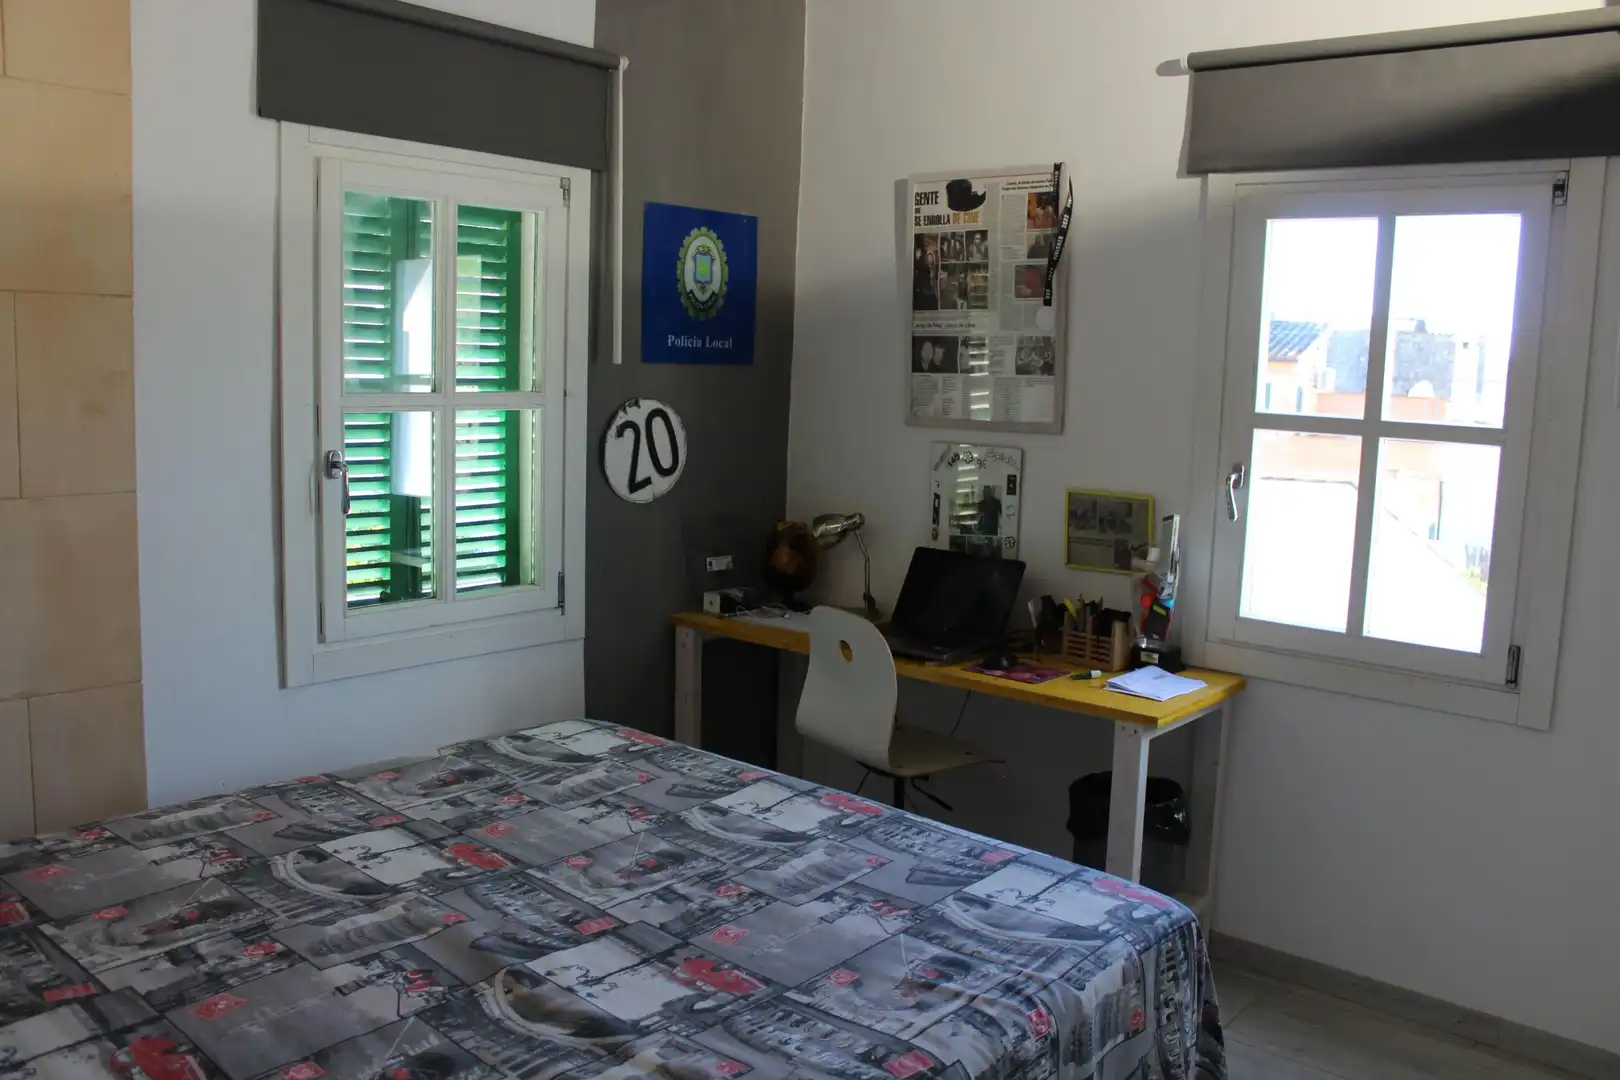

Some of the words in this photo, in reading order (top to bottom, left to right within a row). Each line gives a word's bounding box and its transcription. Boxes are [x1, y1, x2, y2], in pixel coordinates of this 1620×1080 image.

[915, 191, 939, 206] GENTE
[914, 216, 922, 226] SE
[705, 336, 733, 349] Local
[616, 408, 679, 494] 20
